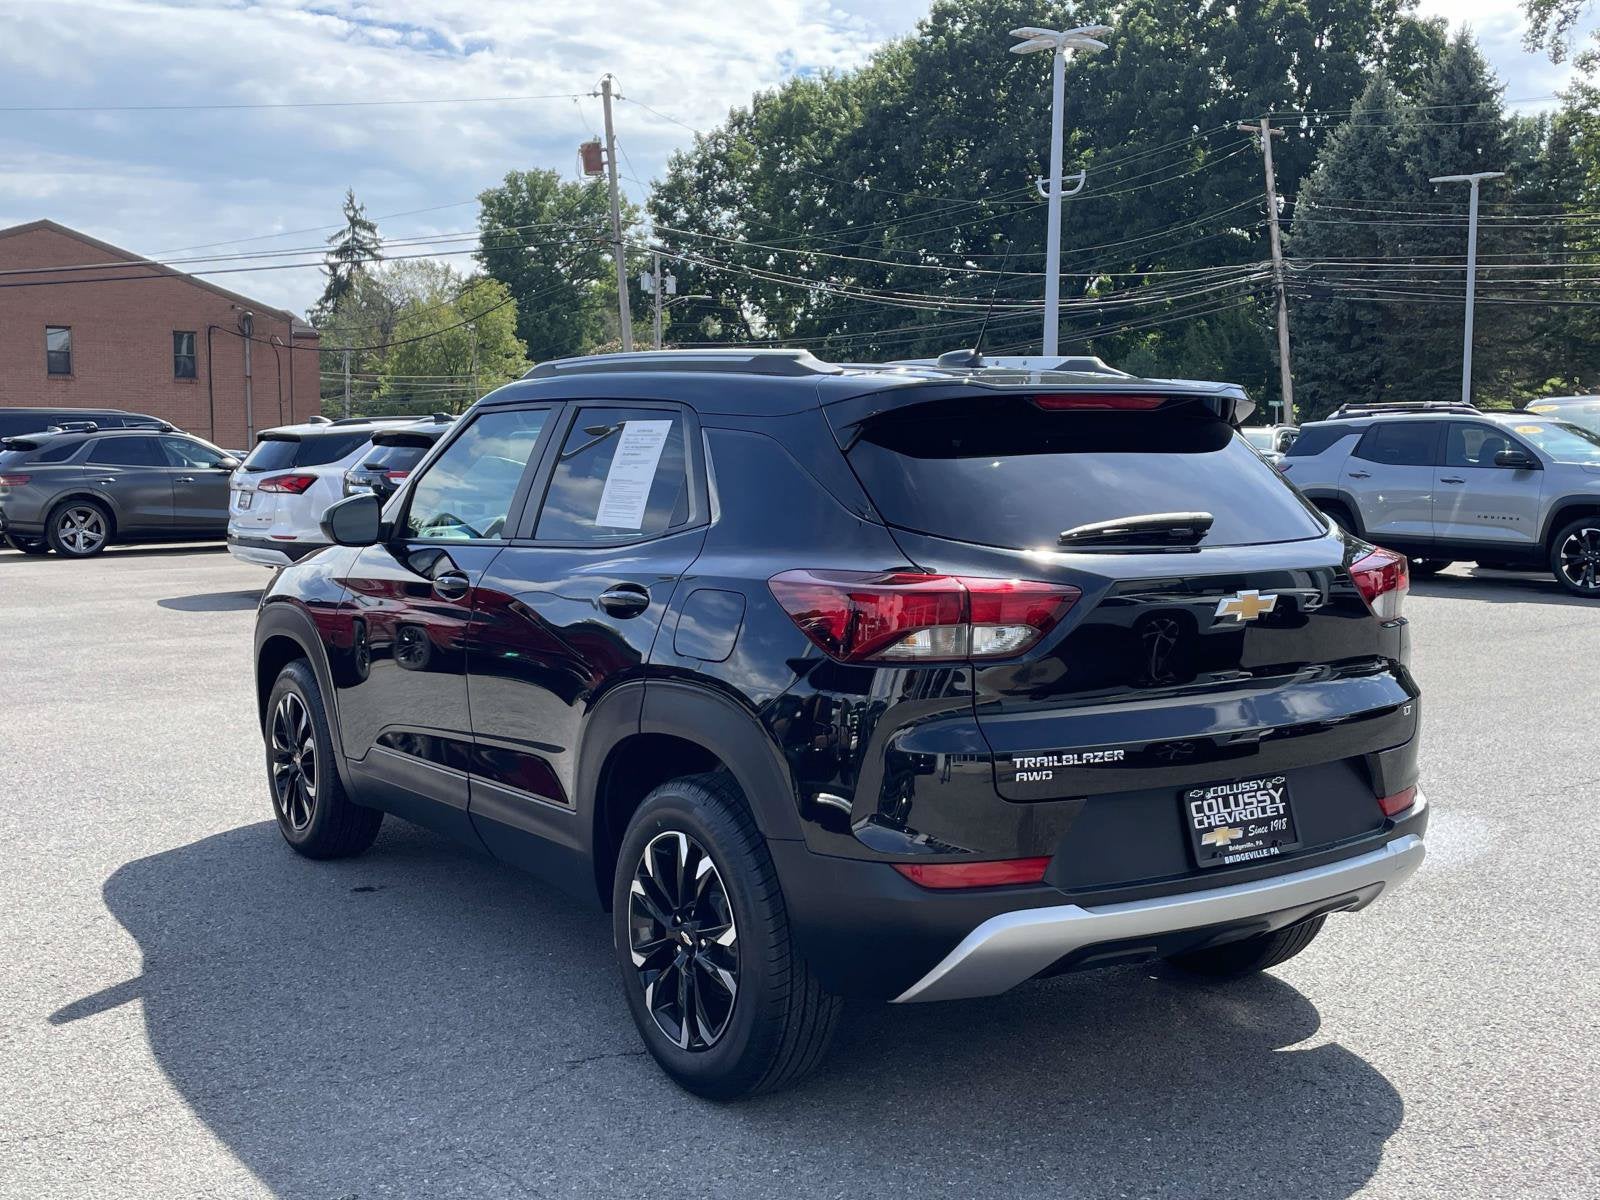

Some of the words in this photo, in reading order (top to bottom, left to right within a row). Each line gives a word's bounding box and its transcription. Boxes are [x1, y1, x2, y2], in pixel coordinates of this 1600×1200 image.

[1012, 749, 1125, 769] TRAILBLAZER
[1015, 770, 1053, 782] AWD
[1210, 779, 1266, 796] COLUSSY
[1190, 787, 1284, 818] COLUSSY
[1193, 802, 1286, 829] CHEVROLET
[1248, 824, 1268, 837] Since
[1270, 818, 1287, 831] 1918
[1270, 847, 1280, 855] PA
